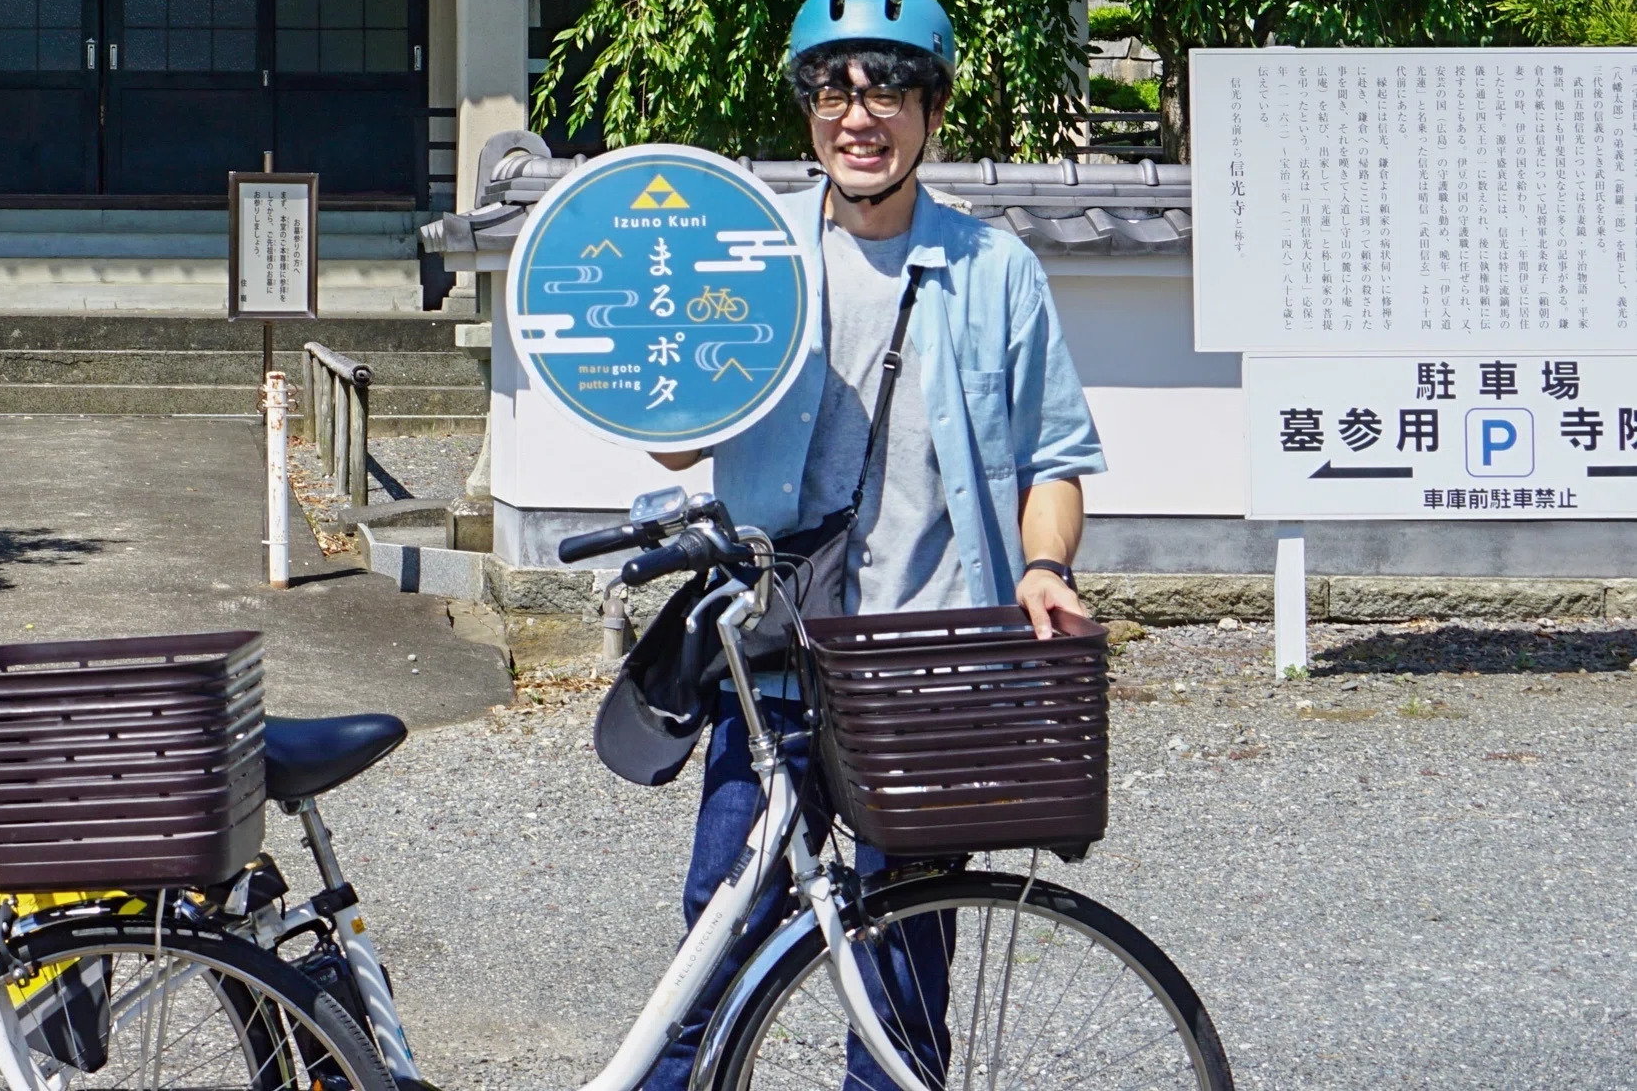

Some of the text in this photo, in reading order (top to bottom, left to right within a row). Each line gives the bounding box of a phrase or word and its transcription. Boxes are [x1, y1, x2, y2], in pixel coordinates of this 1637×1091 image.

[1257, 65, 1270, 128] 伝えている。
[1396, 65, 1408, 139] 代前にあたる。
[1230, 77, 1246, 258] 信光の名前から信光寺と称す。
[614, 215, 707, 228] Izuno Kuni
[646, 237, 686, 410] まるポタ
[1416, 360, 1580, 401] 駐車場
[1279, 407, 1440, 452] 墓参用
[1482, 419, 1517, 466] P
[1423, 487, 1579, 509] 車庫前駐車禁止
[674, 911, 723, 986] HELLO CYCLING
